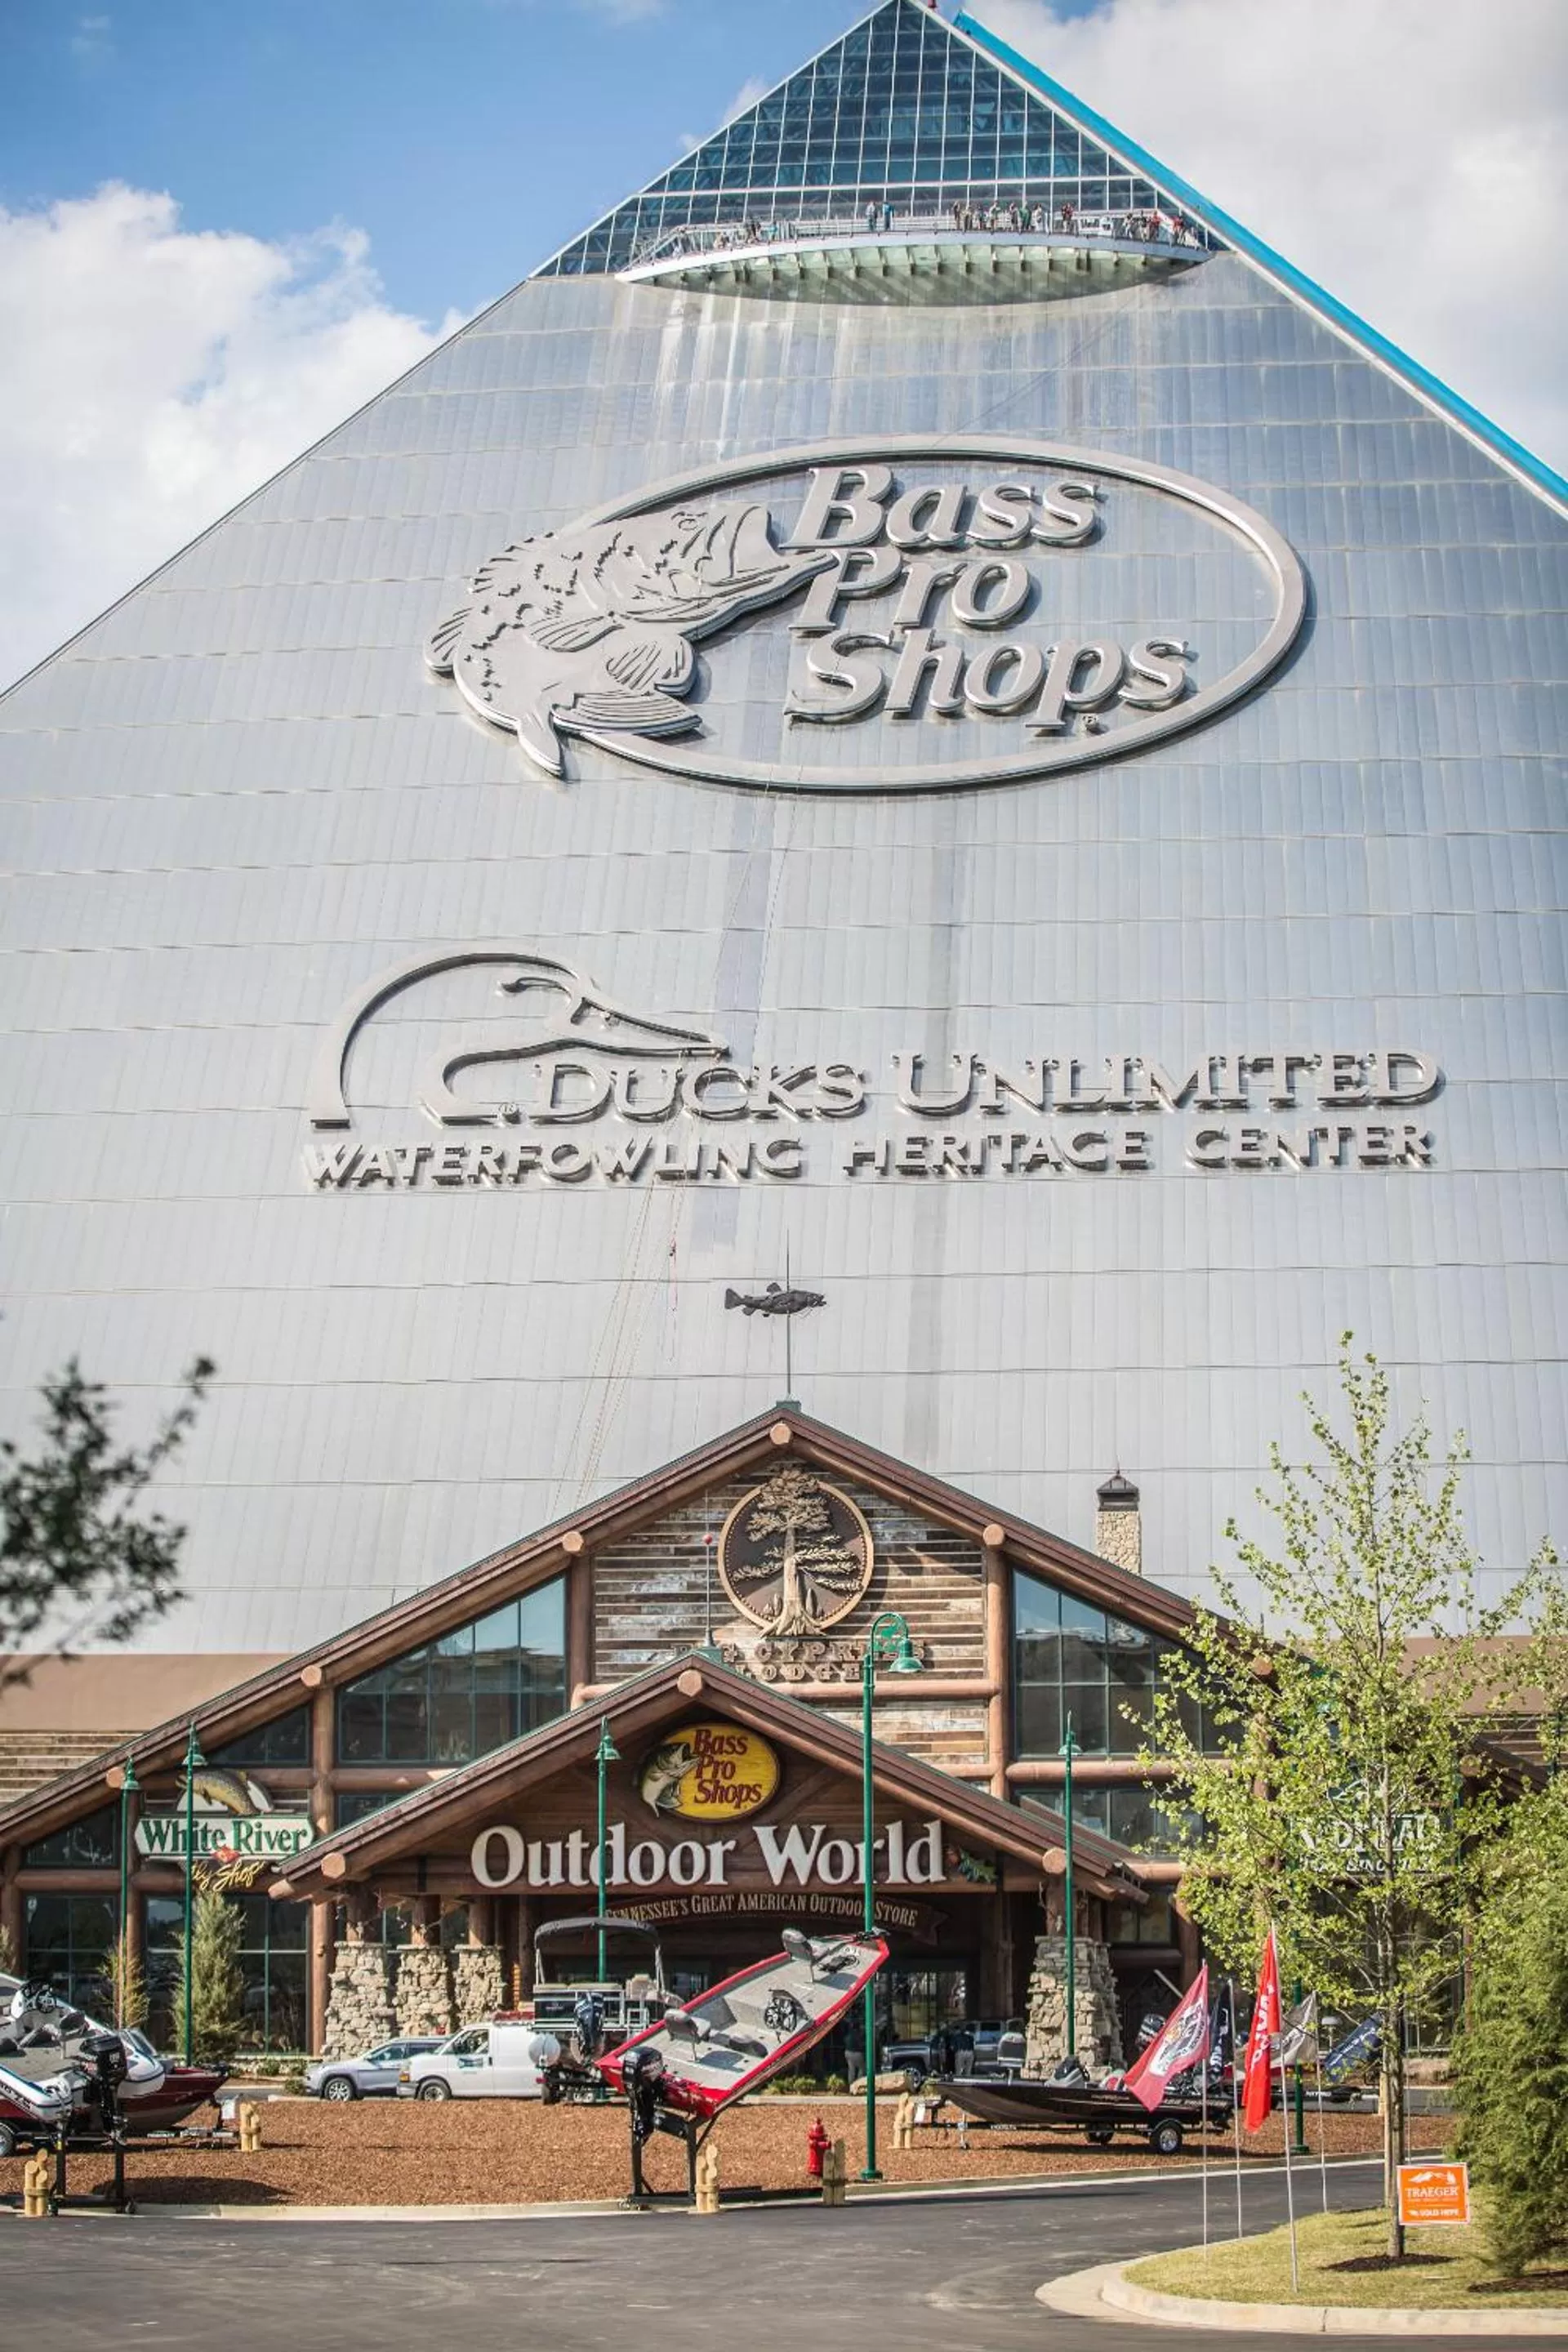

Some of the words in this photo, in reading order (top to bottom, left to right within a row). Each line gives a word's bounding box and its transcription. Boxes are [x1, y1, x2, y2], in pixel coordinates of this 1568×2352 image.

[778, 463, 1101, 549] Bass
[789, 546, 1032, 630] Pro
[784, 628, 1190, 729] Shops
[532, 1063, 866, 1122] DUCKS
[892, 1049, 1440, 1114] UNLIMITED
[305, 1135, 803, 1187] WATERFOWLING
[843, 1127, 1150, 1174] HERITAGE
[1184, 1124, 1434, 1169] CENTER
[693, 1729, 748, 1755] Bass
[695, 1754, 736, 1780] Pro
[695, 1779, 762, 1809] Shops
[141, 1820, 226, 1852] White
[232, 1820, 307, 1854] River
[470, 1822, 735, 1887] Outdoor
[753, 1820, 947, 1886] World
[212, 1858, 265, 1891] Shop
[691, 1894, 734, 1914] GREAT
[737, 1892, 806, 1912] AMERICAN
[809, 1894, 866, 1918] OUTDOO
[875, 1900, 918, 1927] STORE
[1407, 2186, 1459, 2198] TRAEGER
